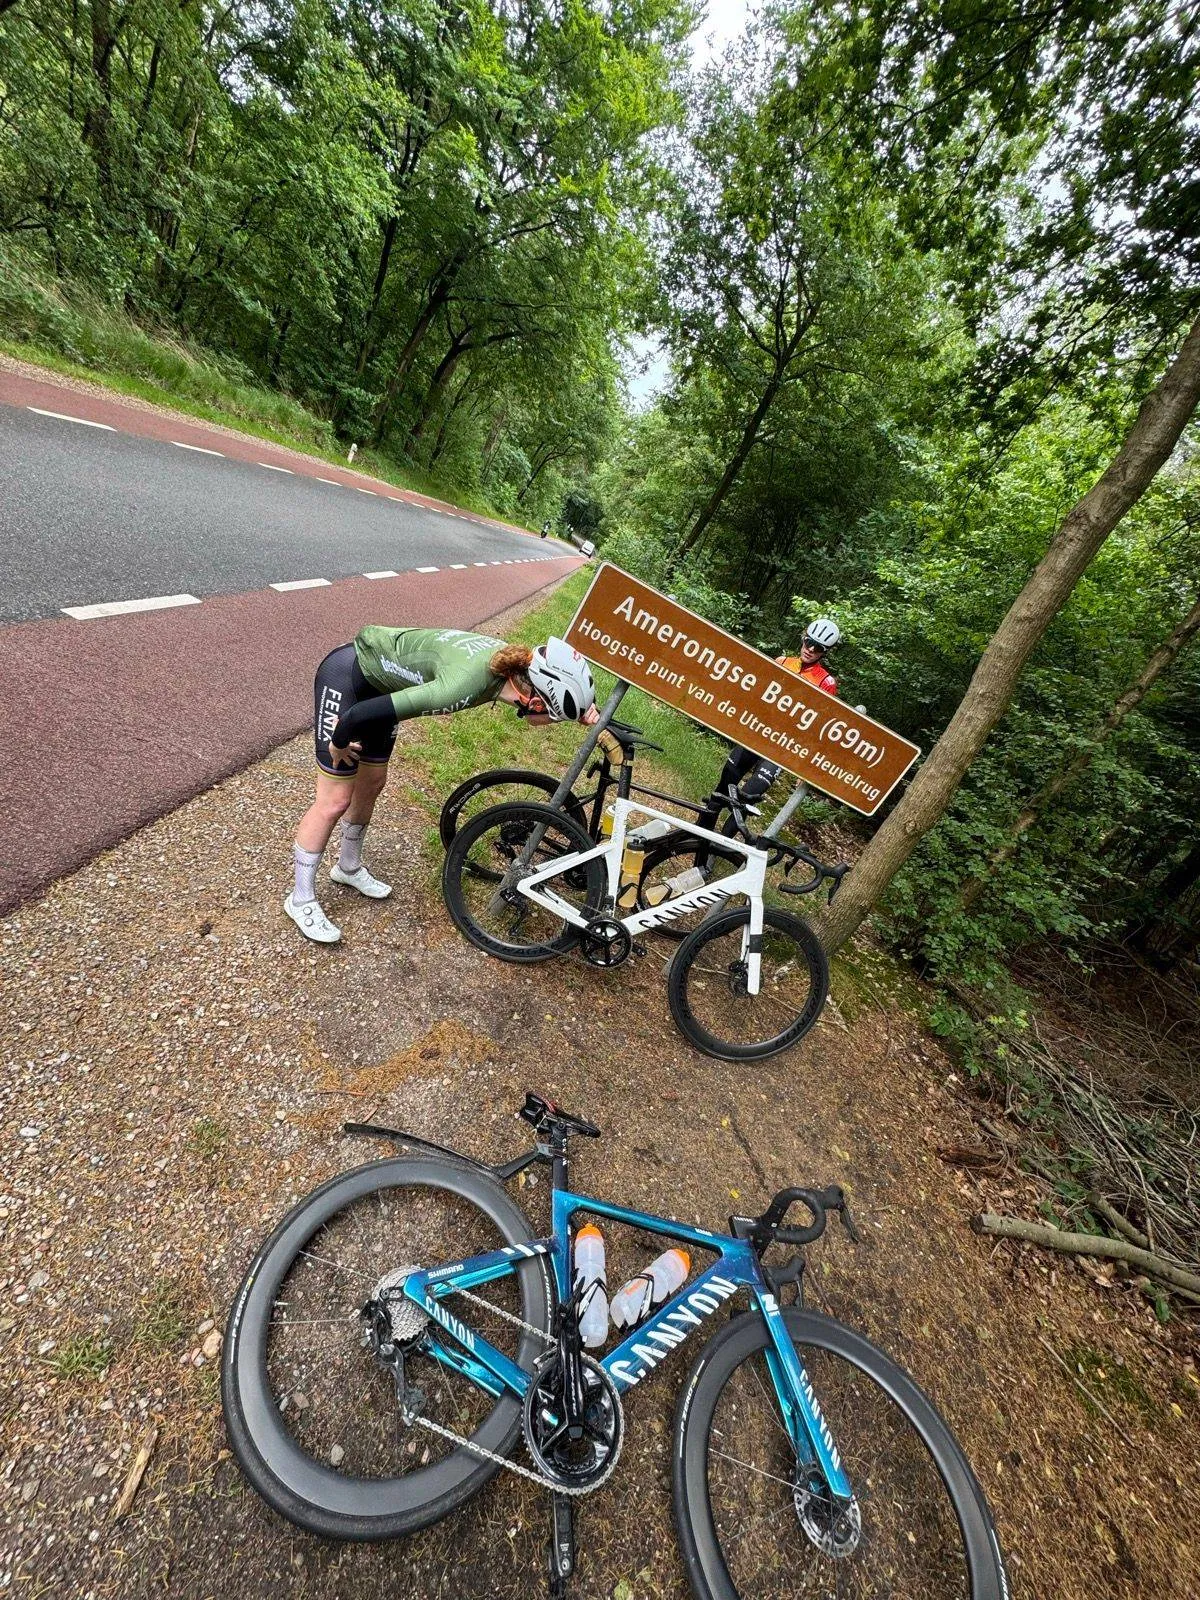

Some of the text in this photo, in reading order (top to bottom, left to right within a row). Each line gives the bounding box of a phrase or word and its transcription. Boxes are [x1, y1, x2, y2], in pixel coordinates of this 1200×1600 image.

[421, 694, 472, 717] FENIX
[546, 679, 563, 716] CANYON
[613, 595, 885, 769] Amerongse Berg (69m)
[322, 688, 342, 741] FENIX
[577, 618, 645, 666] Hoogste
[645, 661, 686, 688] punt
[688, 683, 715, 706] van
[717, 700, 737, 718] de
[739, 710, 809, 759] Utrechtse
[810, 751, 881, 802] Heuvelrug
[638, 888, 733, 928] CANYON
[427, 1263, 465, 1280] SHIMANO
[544, 1275, 552, 1319] PIRELLI
[425, 1295, 475, 1351] CANYON
[609, 1275, 739, 1386] CANYON
[799, 1368, 841, 1473] CANYON
